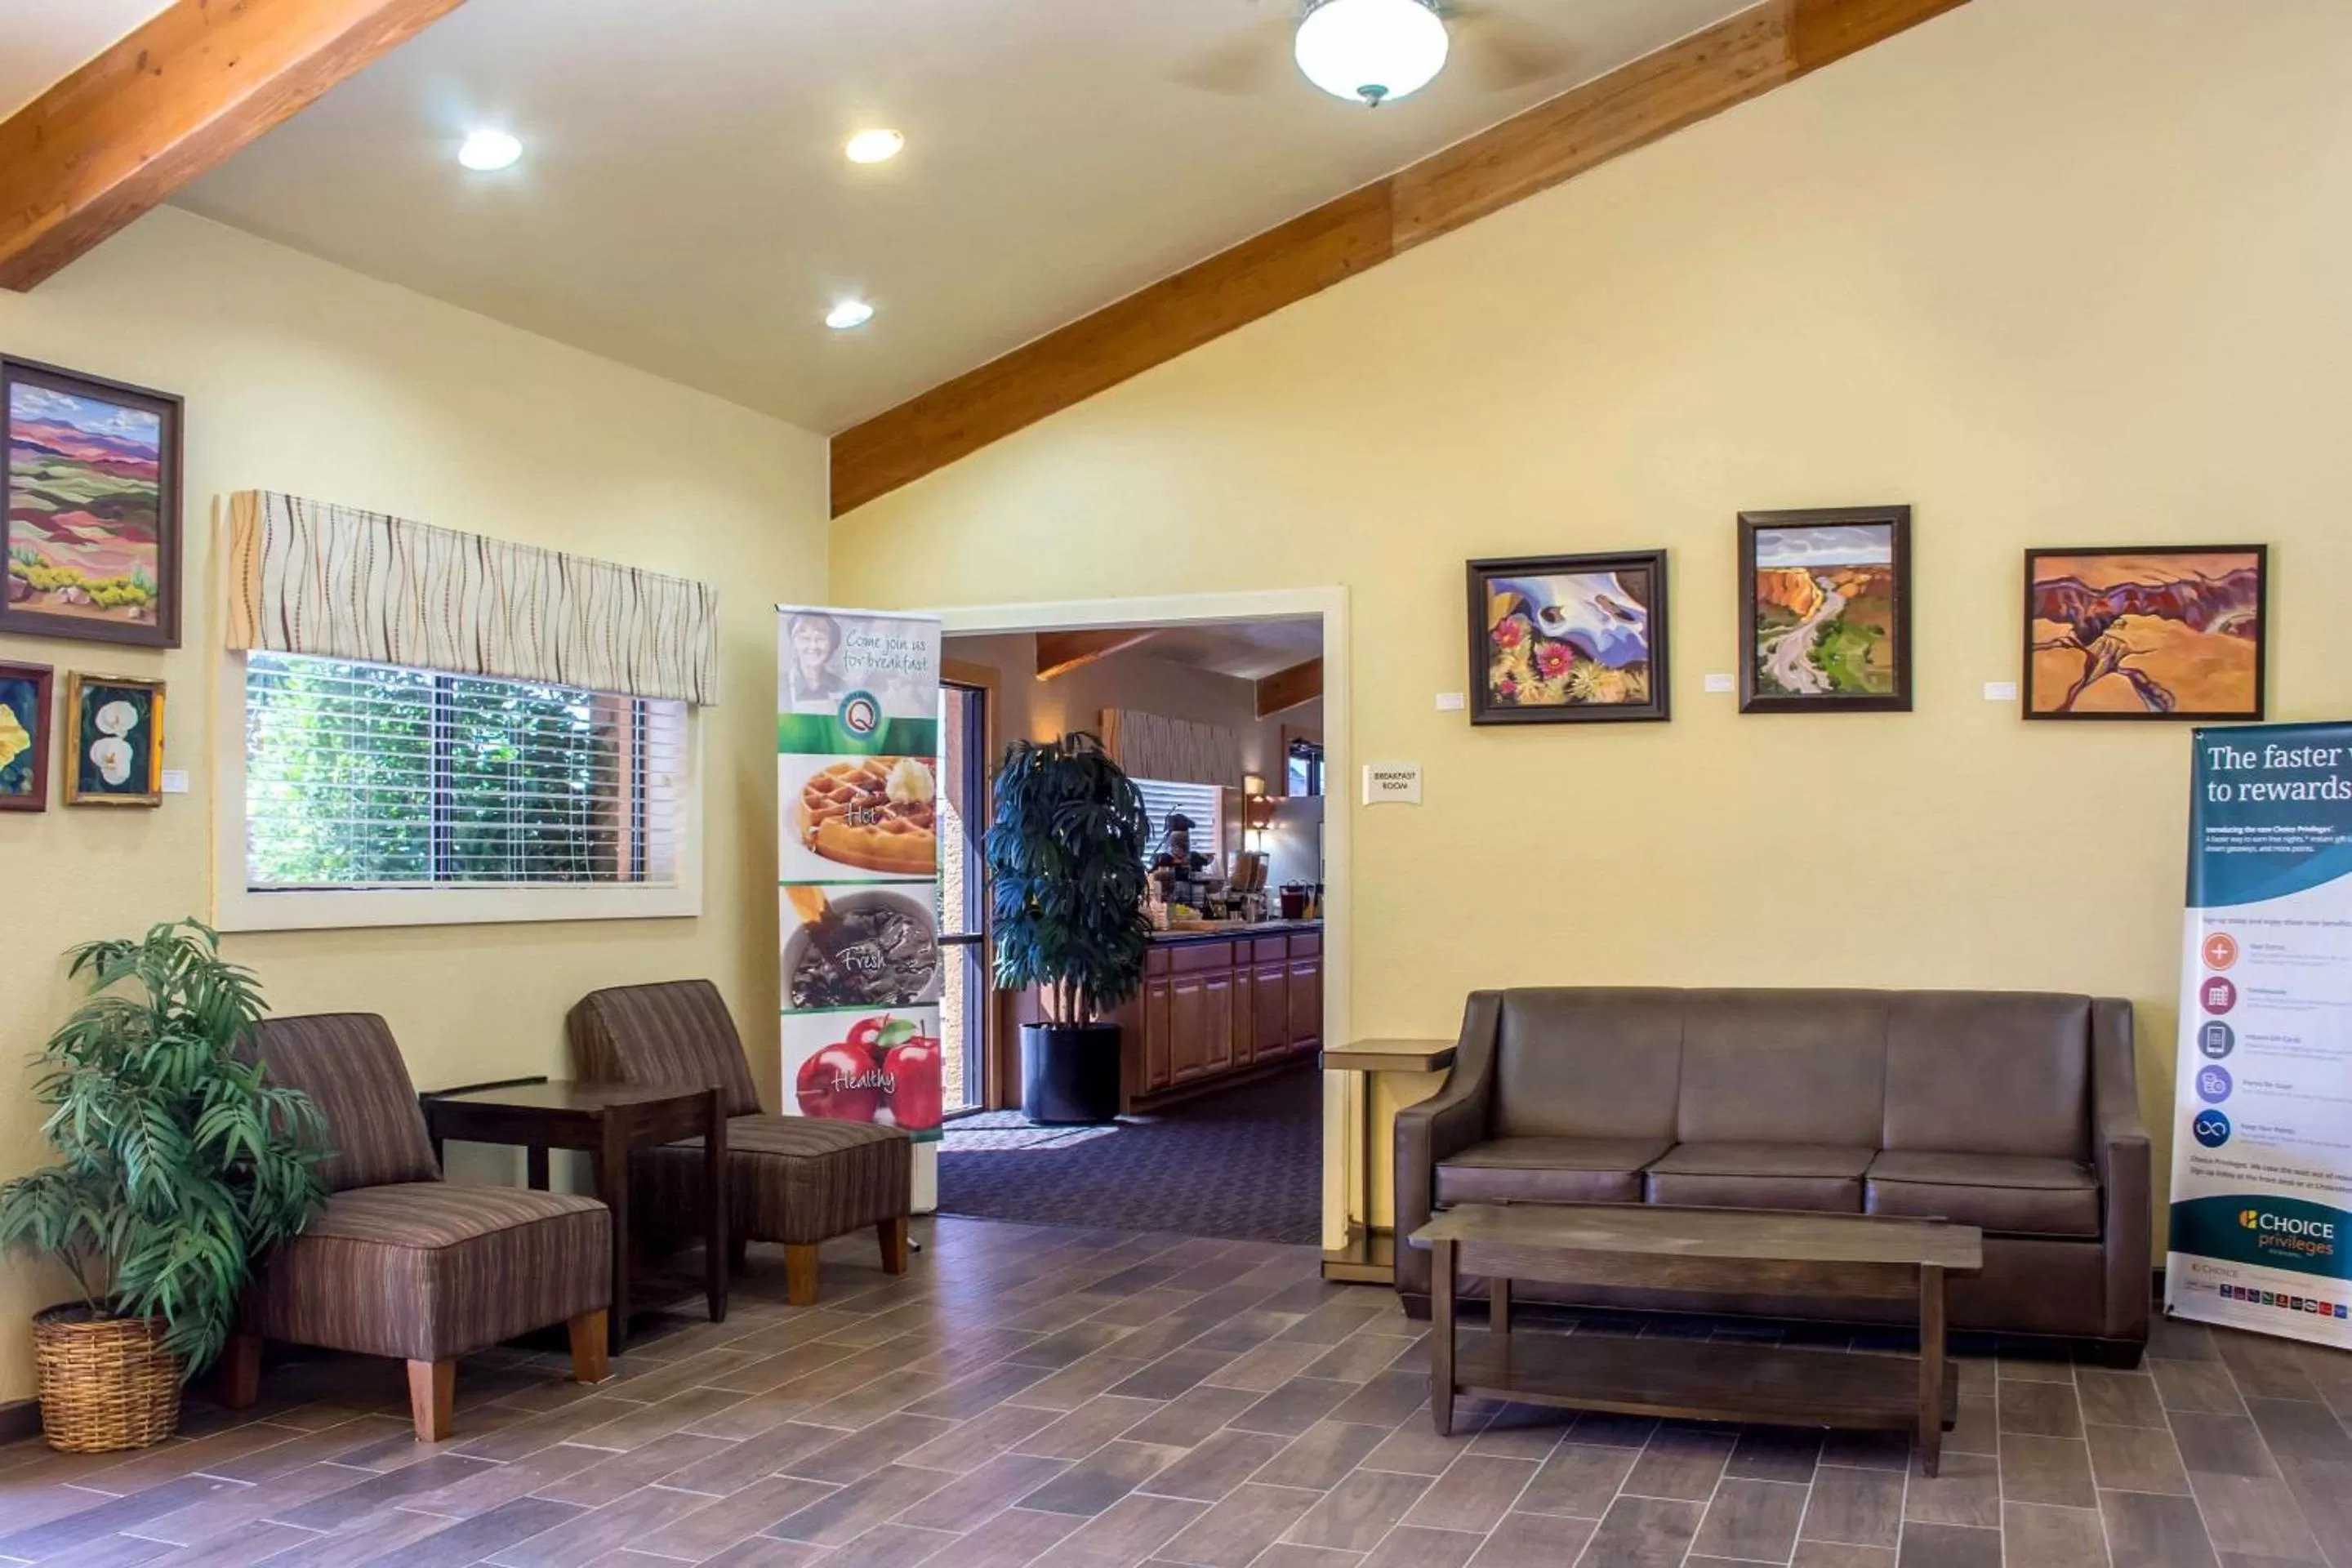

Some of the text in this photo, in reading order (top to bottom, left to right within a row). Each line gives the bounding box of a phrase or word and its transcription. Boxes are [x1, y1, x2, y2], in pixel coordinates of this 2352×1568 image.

[846, 629, 926, 656] Come join us
[843, 650, 928, 675] for breakfast
[848, 701, 875, 731] Q
[2207, 745, 2256, 770] The
[2263, 744, 2342, 769] faster
[1374, 772, 1416, 780] BREAKFAST
[1382, 782, 1408, 790] ROOM
[2207, 775, 2352, 802] to rewards
[844, 801, 878, 826] Hot
[835, 947, 886, 971] Fresh
[831, 1068, 895, 1094] Healthy
[2259, 1213, 2334, 1239] CHOICE
[2258, 1234, 2334, 1257] privileges
